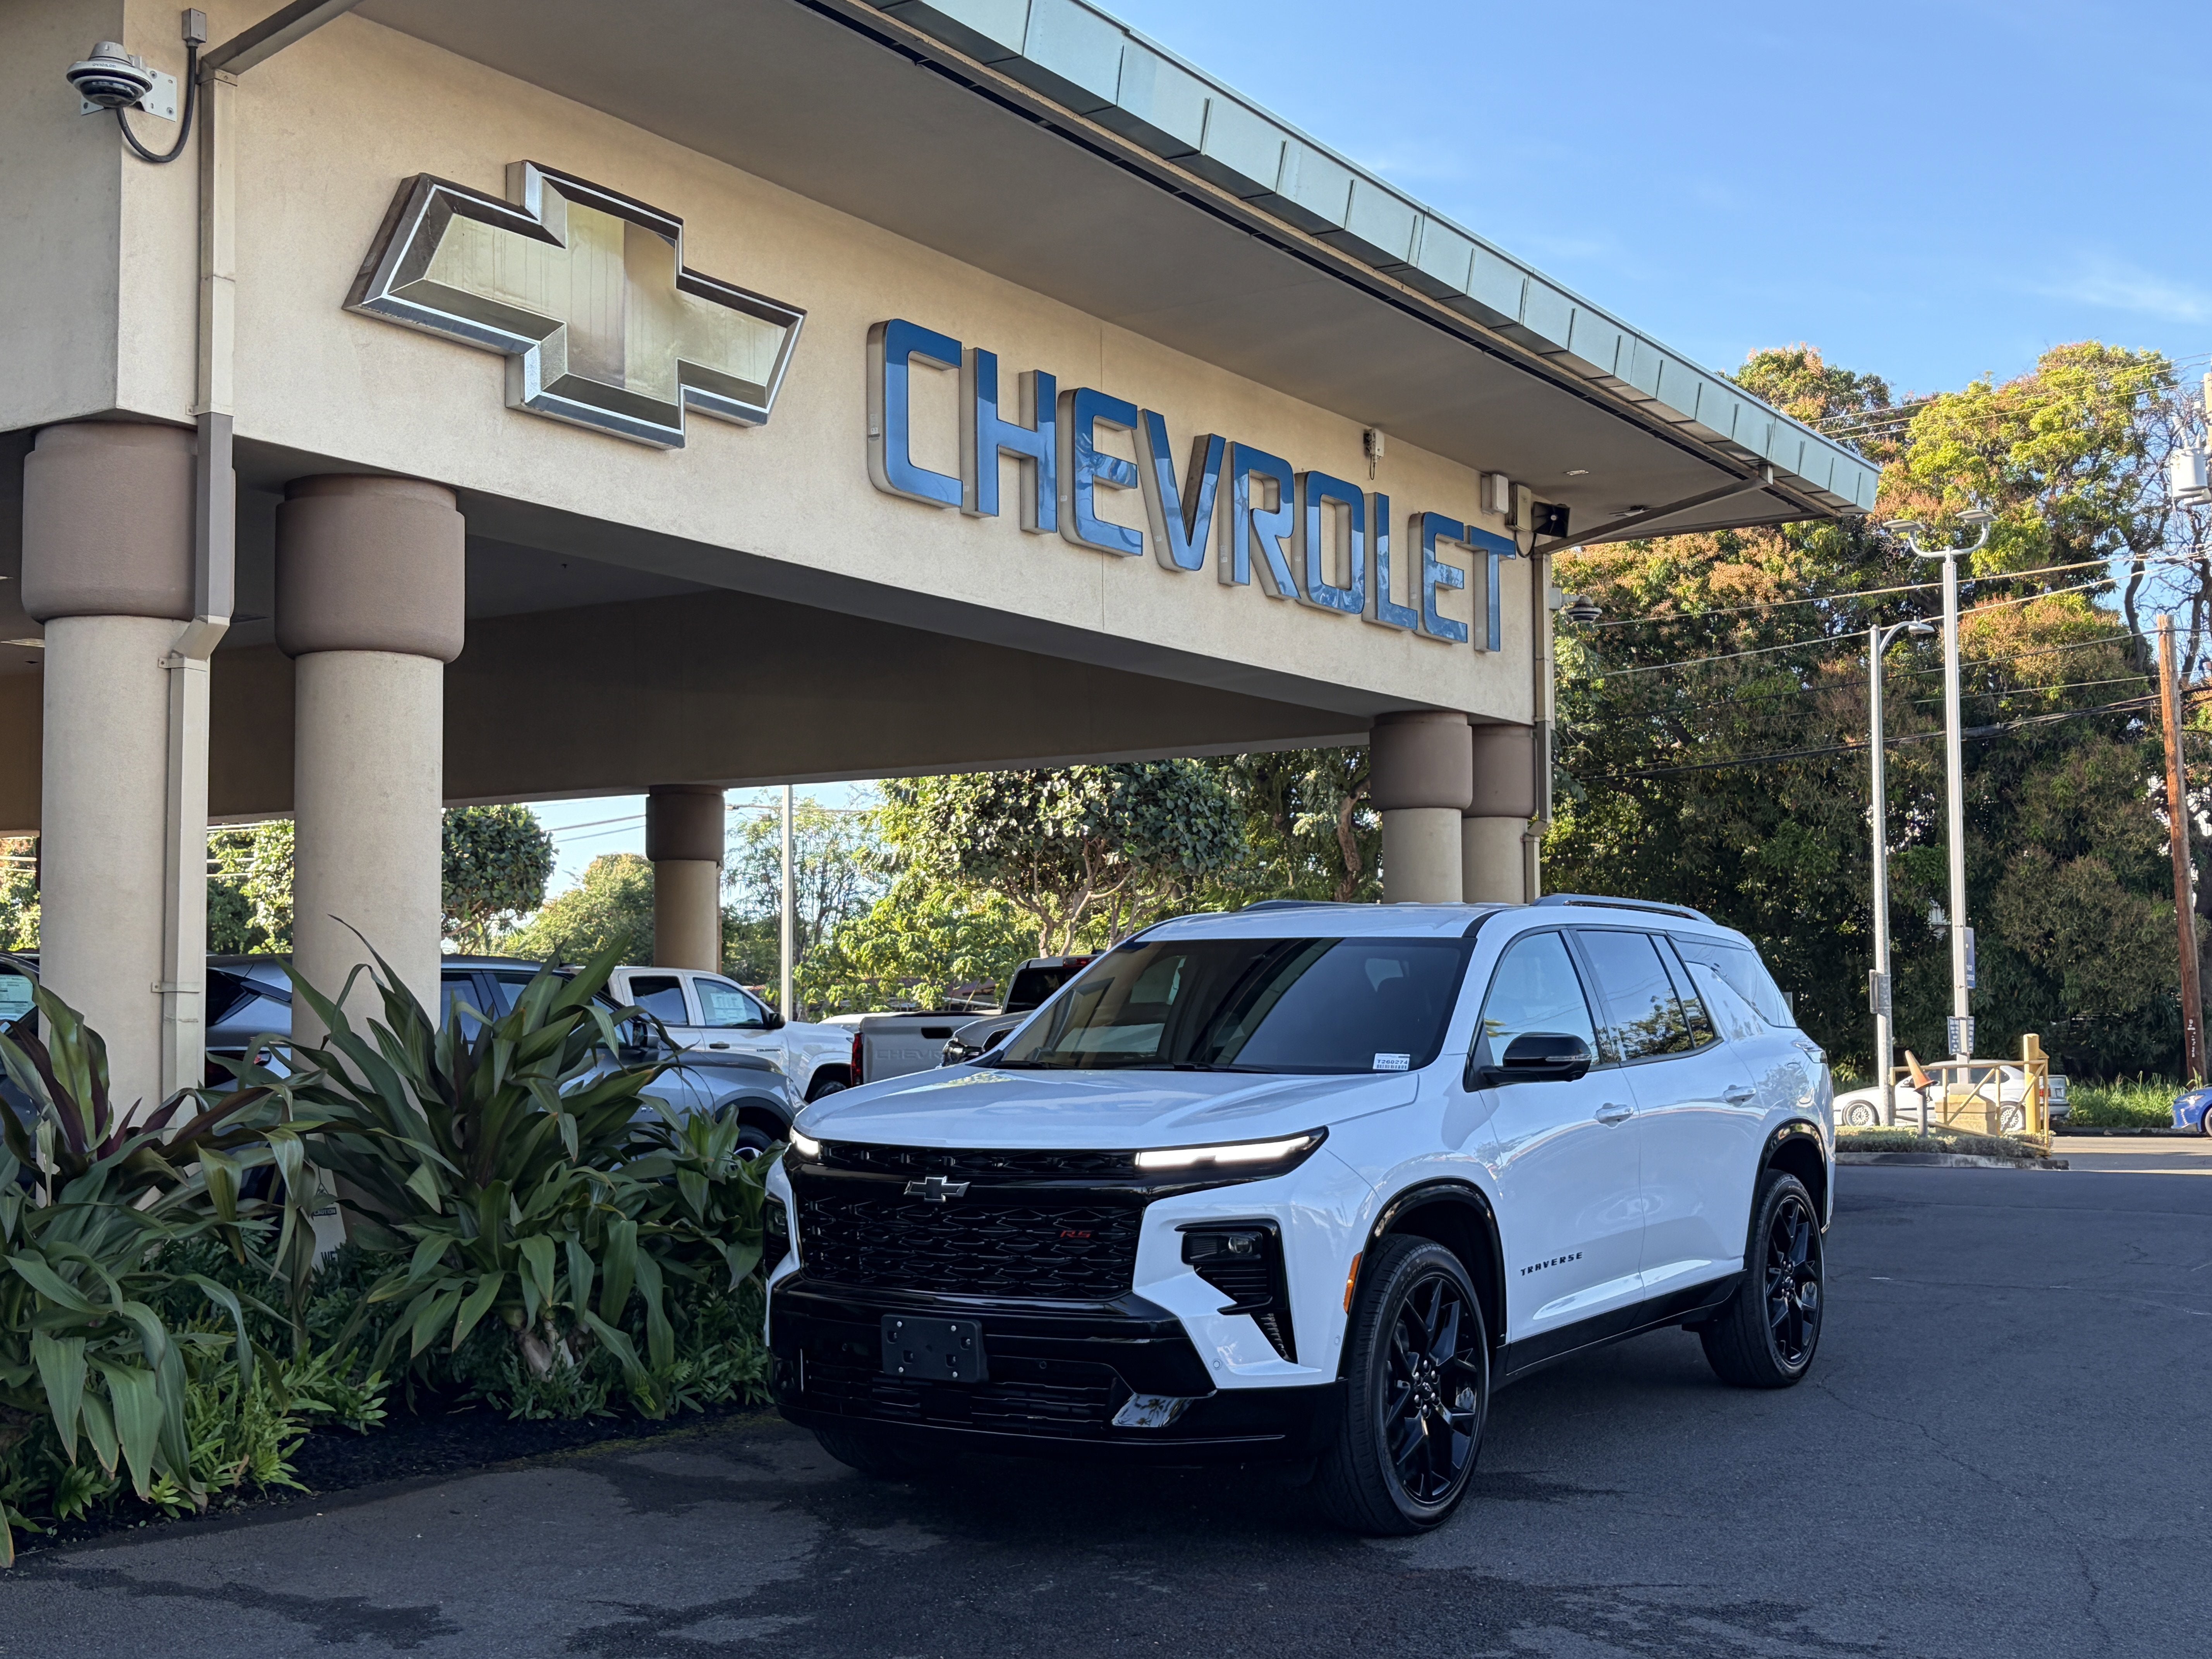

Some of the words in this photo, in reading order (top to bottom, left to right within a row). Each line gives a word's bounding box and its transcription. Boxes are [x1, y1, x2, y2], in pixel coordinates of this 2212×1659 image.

[867, 318, 1516, 653] CHEVROLET
[875, 1049, 944, 1060] CHEVR
[1060, 1230, 1091, 1238] RS
[1520, 1252, 1583, 1276] TRAVERSE
